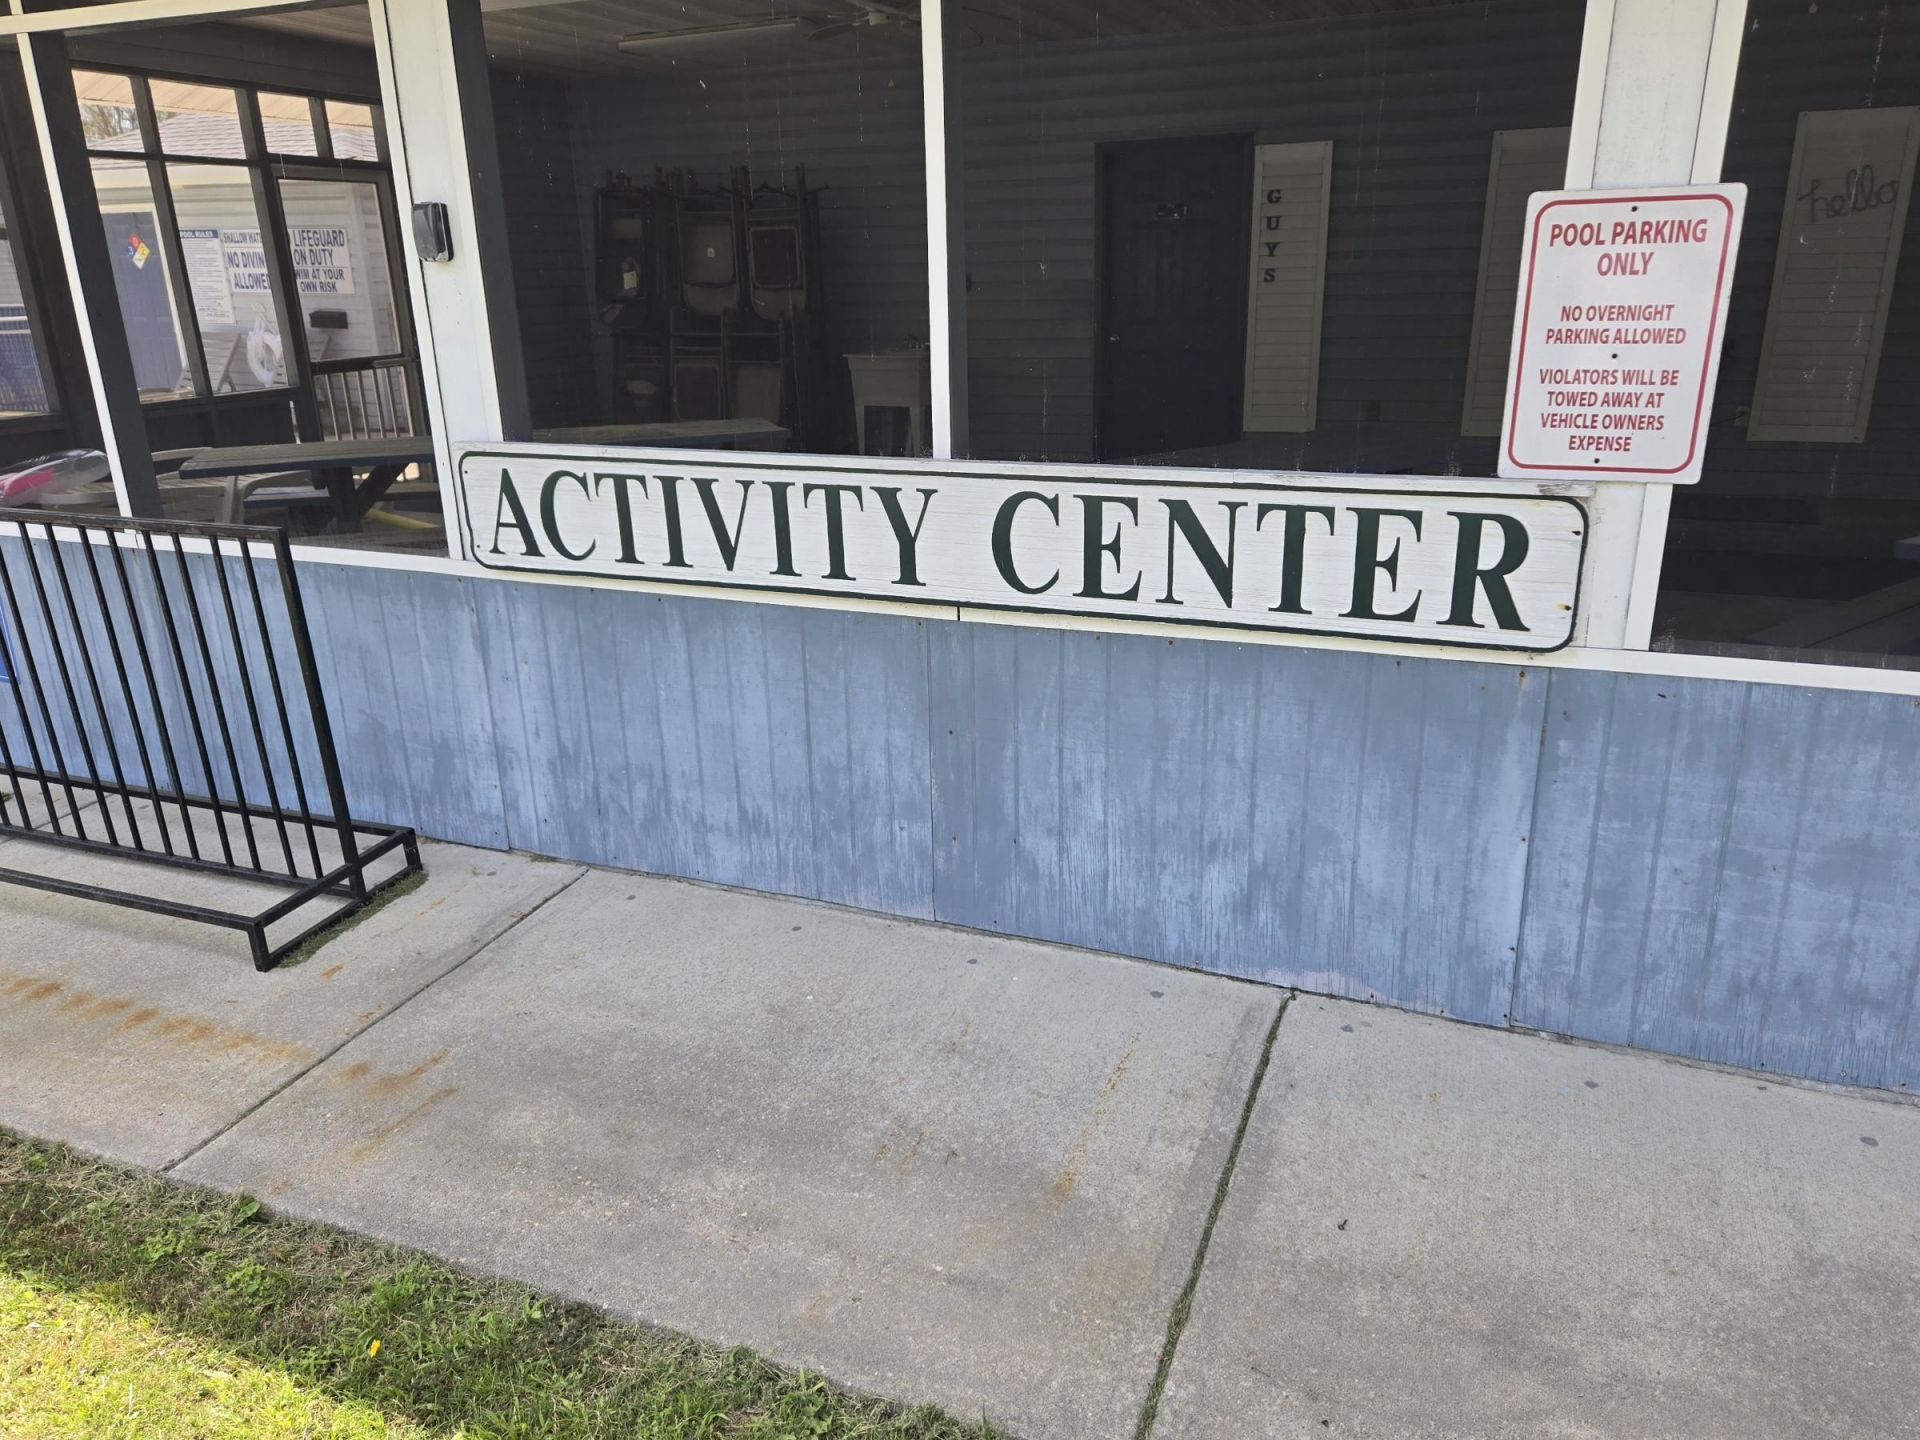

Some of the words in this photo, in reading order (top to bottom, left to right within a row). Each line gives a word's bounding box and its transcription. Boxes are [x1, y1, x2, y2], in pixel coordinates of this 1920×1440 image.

[1797, 164, 1899, 223] hello
[223, 232, 248, 244] SHALLOW
[248, 232, 262, 244] WAT
[292, 229, 345, 247] LIFEGUARD
[1263, 189, 1282, 283] GUYS
[1549, 222, 1606, 247] POOL
[1611, 219, 1708, 245] PARKING
[227, 251, 240, 268] NO
[240, 251, 266, 268] DIVIN
[293, 249, 308, 266] ON
[308, 248, 334, 266] DUTY
[1597, 252, 1655, 276] ONLY
[295, 268, 310, 280] WIM
[312, 268, 321, 280] AT
[322, 269, 345, 280] YOUR
[300, 281, 318, 292] OWN
[319, 281, 337, 293] RISK
[1560, 305, 1582, 322] NO
[1586, 304, 1674, 321] OVERNIGHT
[1545, 328, 1609, 345] PARKING
[1612, 328, 1686, 345] ALLOWED
[1539, 368, 1618, 385] VIOLATORS
[1621, 369, 1656, 385] WILL
[1660, 369, 1680, 386] BE
[1547, 391, 1597, 407] TOWED
[1600, 392, 1643, 408] AWAY
[1645, 392, 1665, 408] AT
[1540, 413, 1599, 429] VEHICLE
[1601, 414, 1665, 431] OWNERS
[1568, 435, 1632, 452] EXPENSE
[489, 467, 938, 587] ACTIVITY
[991, 490, 1531, 632] CENTER
